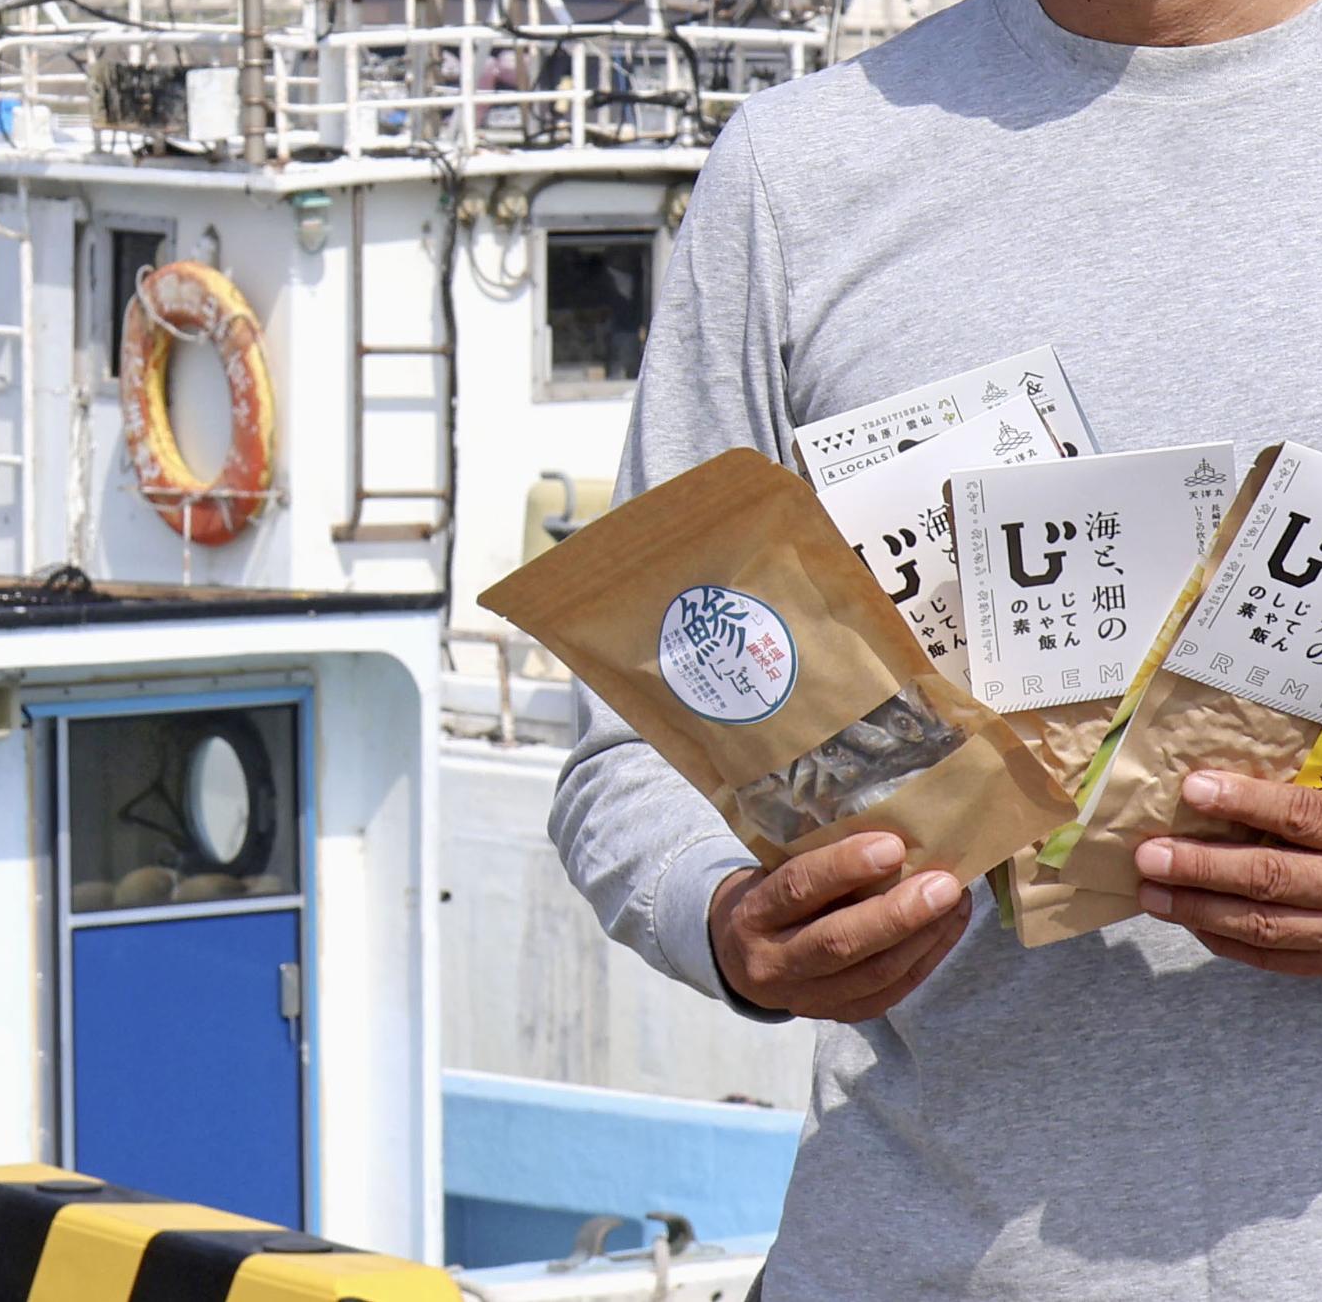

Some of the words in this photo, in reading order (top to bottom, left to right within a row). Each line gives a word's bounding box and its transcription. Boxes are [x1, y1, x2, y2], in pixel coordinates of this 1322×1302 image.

[861, 403, 930, 430] TRADITIONAL
[839, 453, 889, 476] LOCALS
[1189, 489, 1224, 499] 天洋丸
[1001, 520, 1077, 588] じ
[1085, 511, 1127, 641] 海と、畑の
[1011, 600, 1031, 636] の素
[1061, 592, 1080, 648] じてん
[1236, 585, 1267, 620] の素
[1272, 600, 1311, 652] じてん
